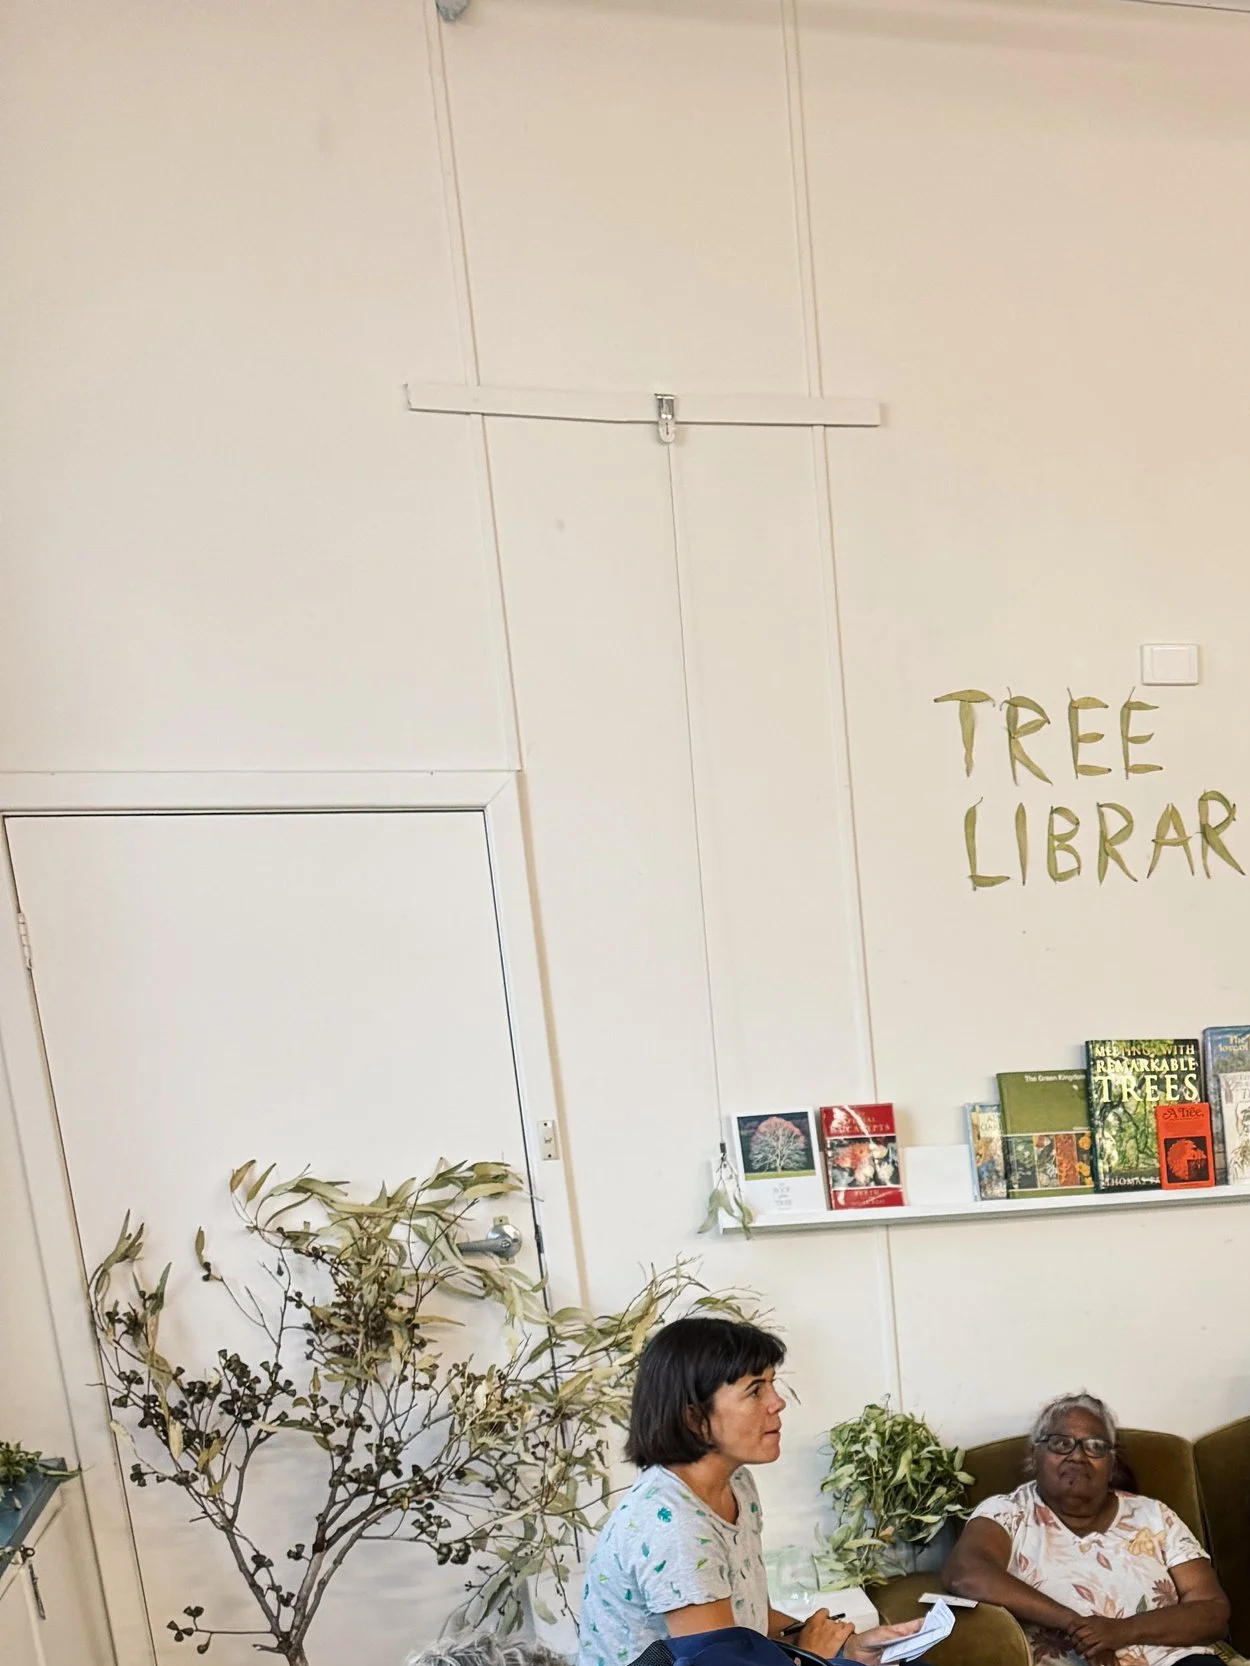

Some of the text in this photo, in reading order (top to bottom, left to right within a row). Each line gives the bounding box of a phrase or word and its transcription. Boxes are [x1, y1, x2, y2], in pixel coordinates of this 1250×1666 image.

[933, 687, 1164, 787] TREE
[1163, 1044, 1195, 1055] WITH
[1095, 1057, 1197, 1073] REMARKABLE
[1024, 1074, 1037, 1082] The
[1092, 1073, 1199, 1103] TREES
